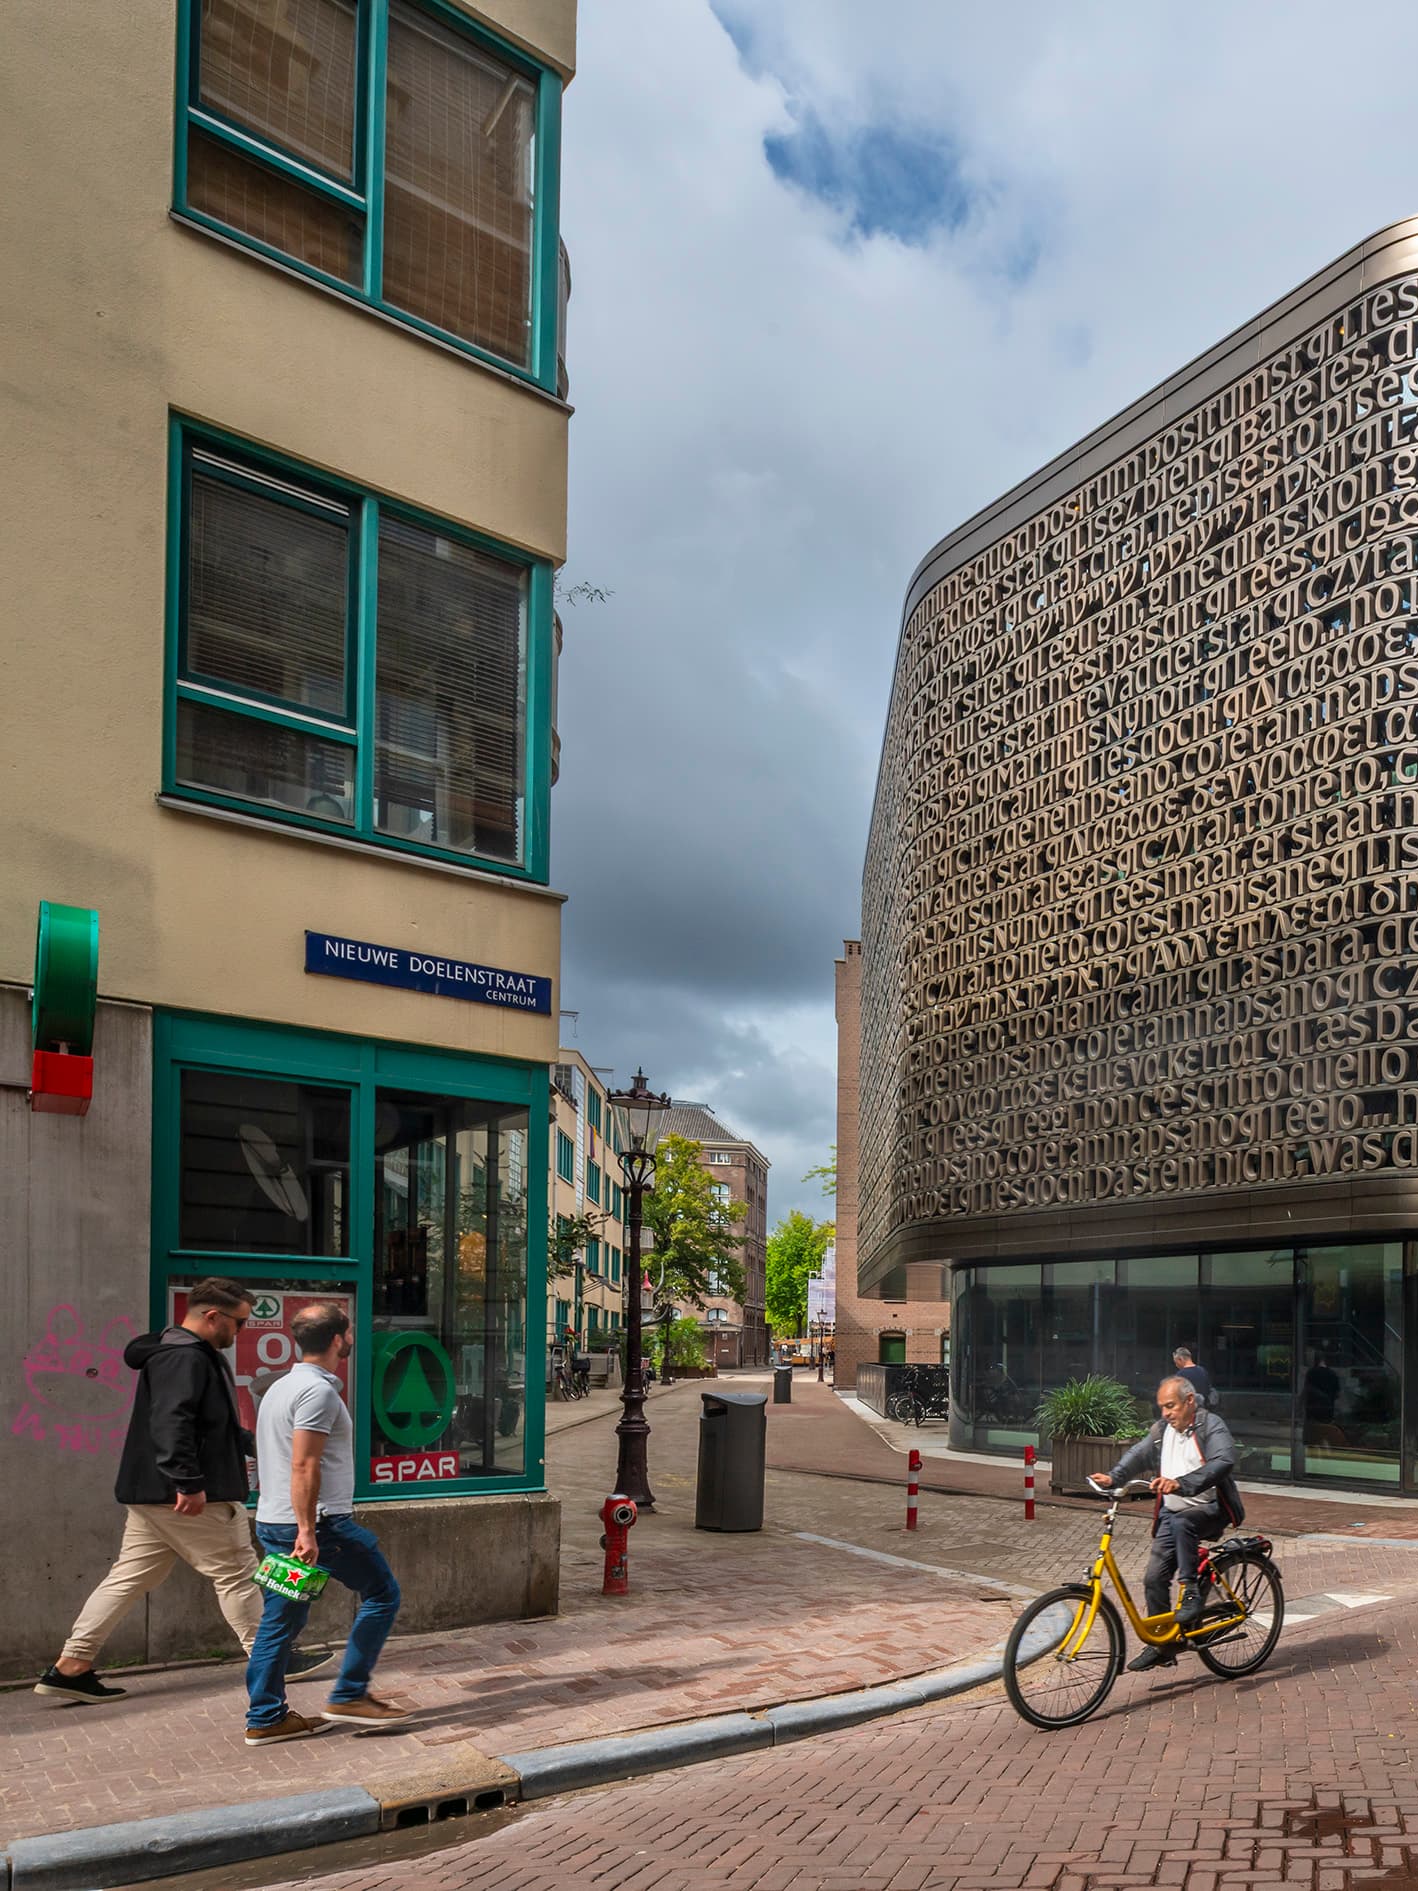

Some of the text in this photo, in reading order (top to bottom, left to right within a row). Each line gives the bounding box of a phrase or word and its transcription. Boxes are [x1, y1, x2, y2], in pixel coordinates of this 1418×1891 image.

[1342, 276, 1418, 348] Lies
[325, 940, 536, 994] NIEUWE DOELENSTRAAT
[486, 989, 536, 1007] CENTRUM
[248, 1320, 282, 1328] SPAR
[374, 1456, 457, 1483] SPAR
